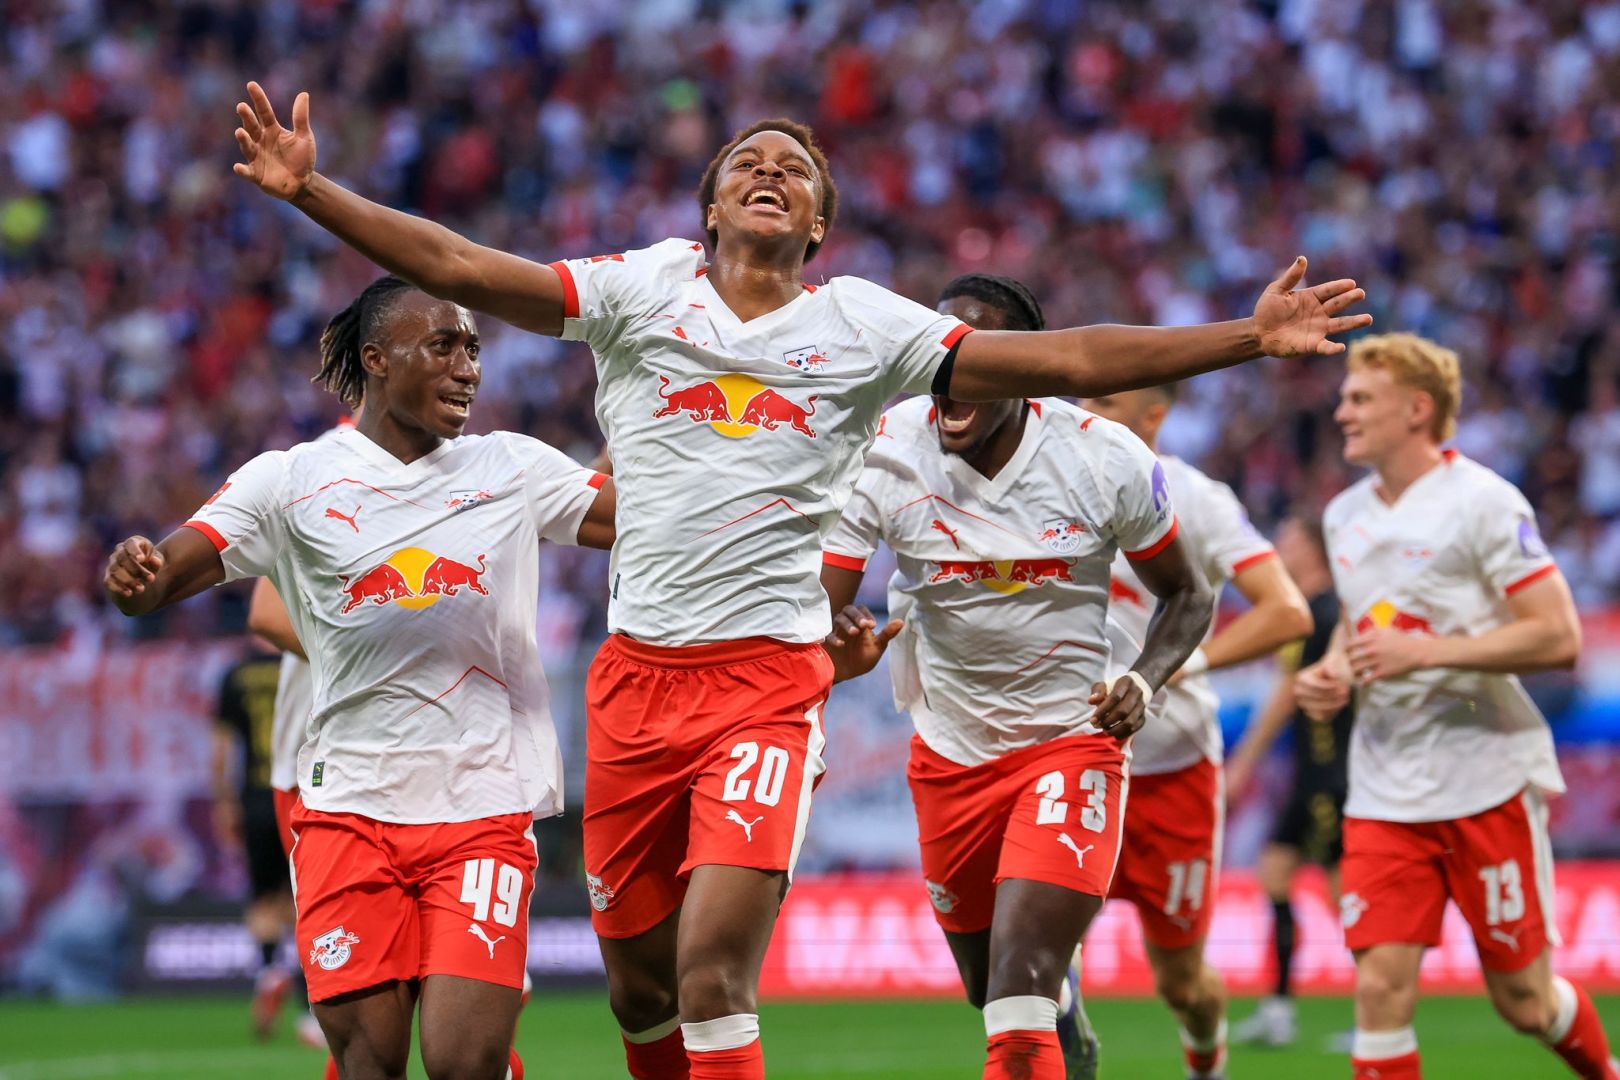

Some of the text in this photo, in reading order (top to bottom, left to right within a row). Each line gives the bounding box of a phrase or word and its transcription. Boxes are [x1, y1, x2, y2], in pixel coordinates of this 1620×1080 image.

[721, 741, 790, 807] 20
[1035, 768, 1107, 834] 23
[459, 858, 524, 929] 49
[1163, 858, 1207, 916] 14
[1477, 858, 1525, 926] 13
